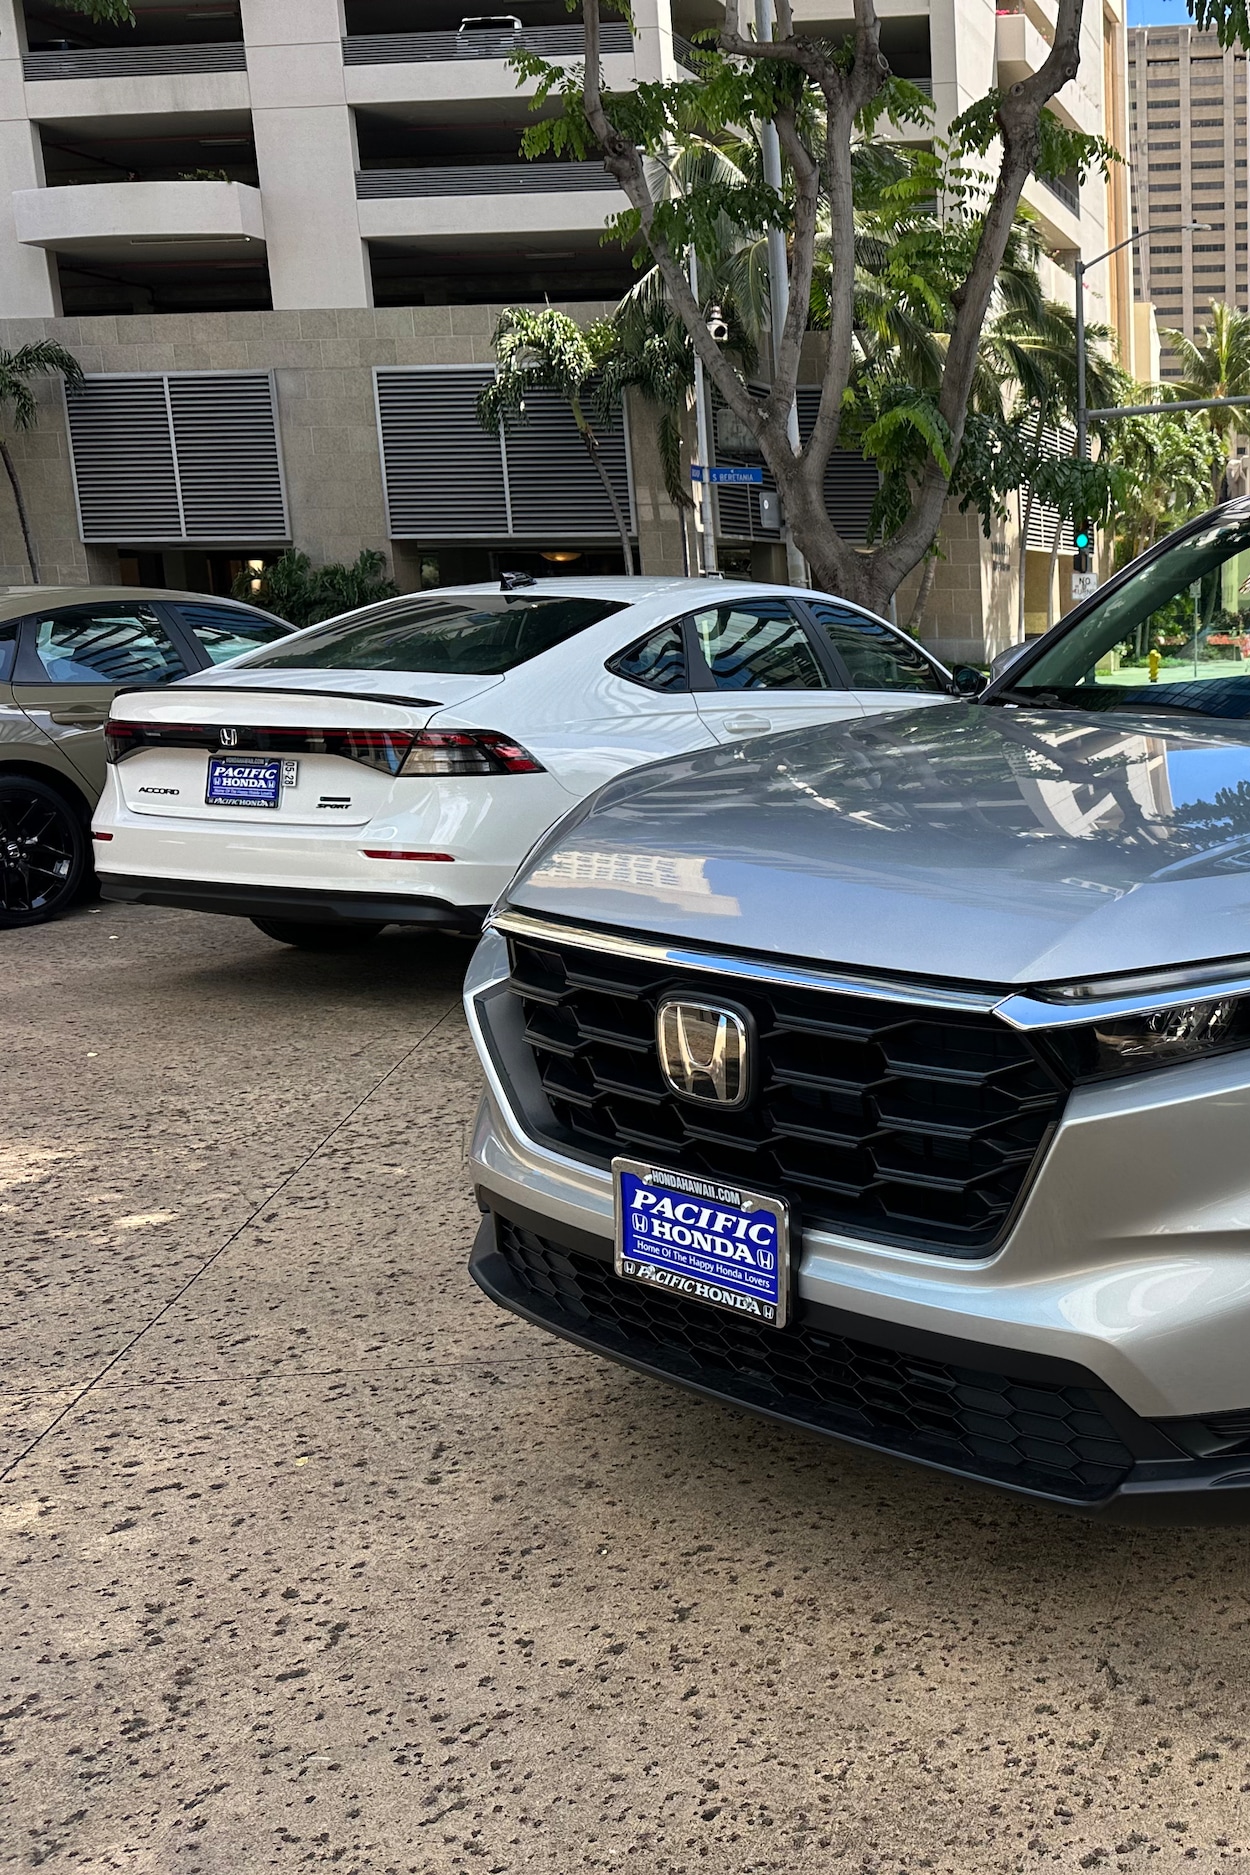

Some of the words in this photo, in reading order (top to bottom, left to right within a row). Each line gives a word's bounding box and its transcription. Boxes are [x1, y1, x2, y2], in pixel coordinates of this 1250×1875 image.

[1079, 577, 1091, 585] NO
[138, 786, 180, 795] ACCORD
[213, 766, 277, 779] PACIFIC
[222, 777, 267, 788] HONDA
[651, 1170, 741, 1206] HONDAHAWAII.COM
[630, 1188, 774, 1246] PACIFIC
[651, 1217, 757, 1266] HONDA
[637, 1240, 660, 1256] Home
[662, 1247, 671, 1258] Of
[673, 1250, 687, 1263] The
[689, 1254, 714, 1272] Happy
[716, 1261, 743, 1280] Honda
[745, 1269, 770, 1288] Lovers
[637, 1265, 695, 1293] PACIFIC
[695, 1282, 762, 1316] HONDA
